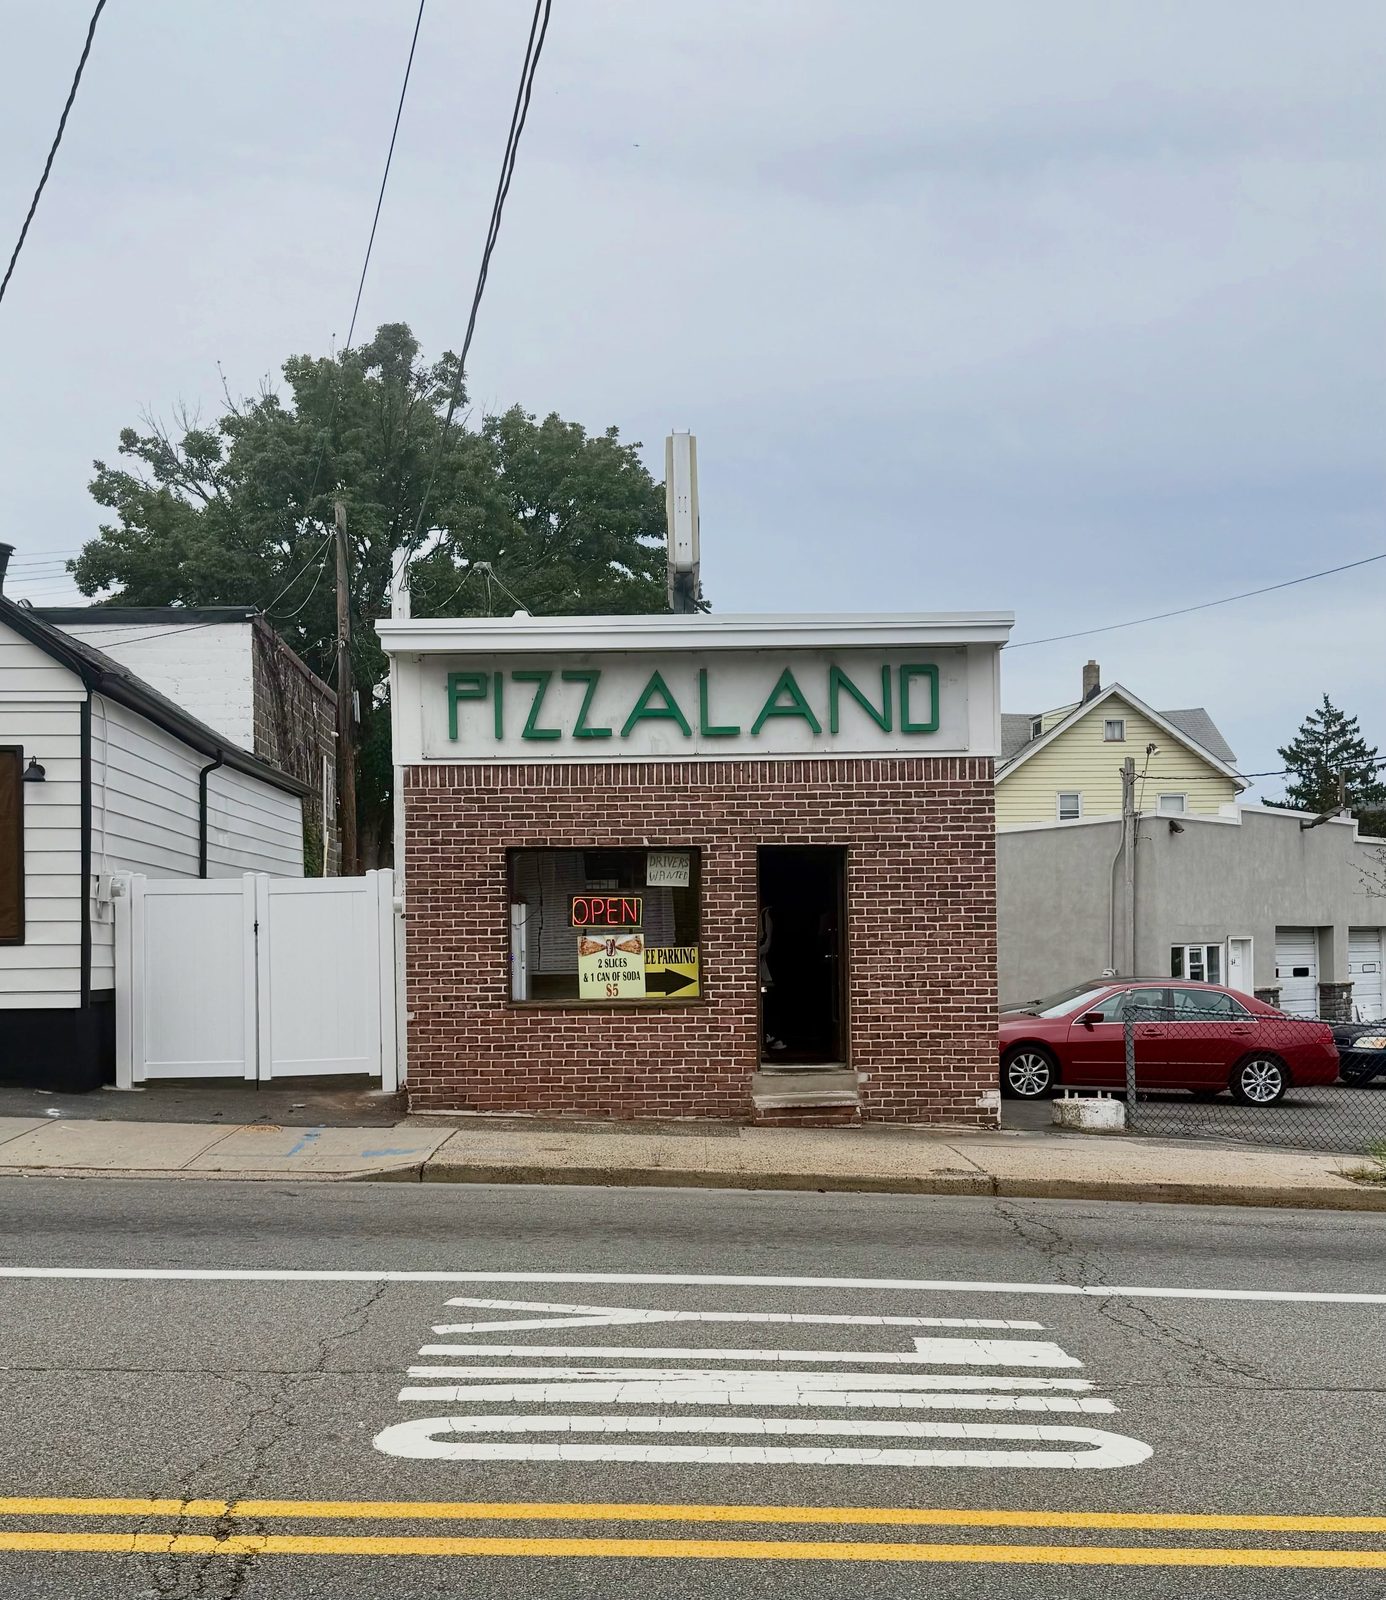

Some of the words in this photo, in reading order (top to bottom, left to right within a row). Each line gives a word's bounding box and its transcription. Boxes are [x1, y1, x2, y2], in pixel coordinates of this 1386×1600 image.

[447, 663, 940, 740] PIZZALAND
[649, 856, 689, 868] DRIVERS
[649, 870, 688, 881] WANTED
[573, 898, 637, 924] OPEN
[644, 949, 656, 964] EE
[657, 948, 696, 964] PARKING
[597, 958, 603, 969] 2
[604, 958, 628, 968] SLICES
[583, 973, 589, 982] &
[590, 973, 594, 982] 1
[597, 972, 610, 982] CAN
[612, 971, 621, 981] OF
[622, 971, 641, 981] SODA
[606, 983, 619, 997] $5
[373, 1296, 1154, 1471] ONLY
